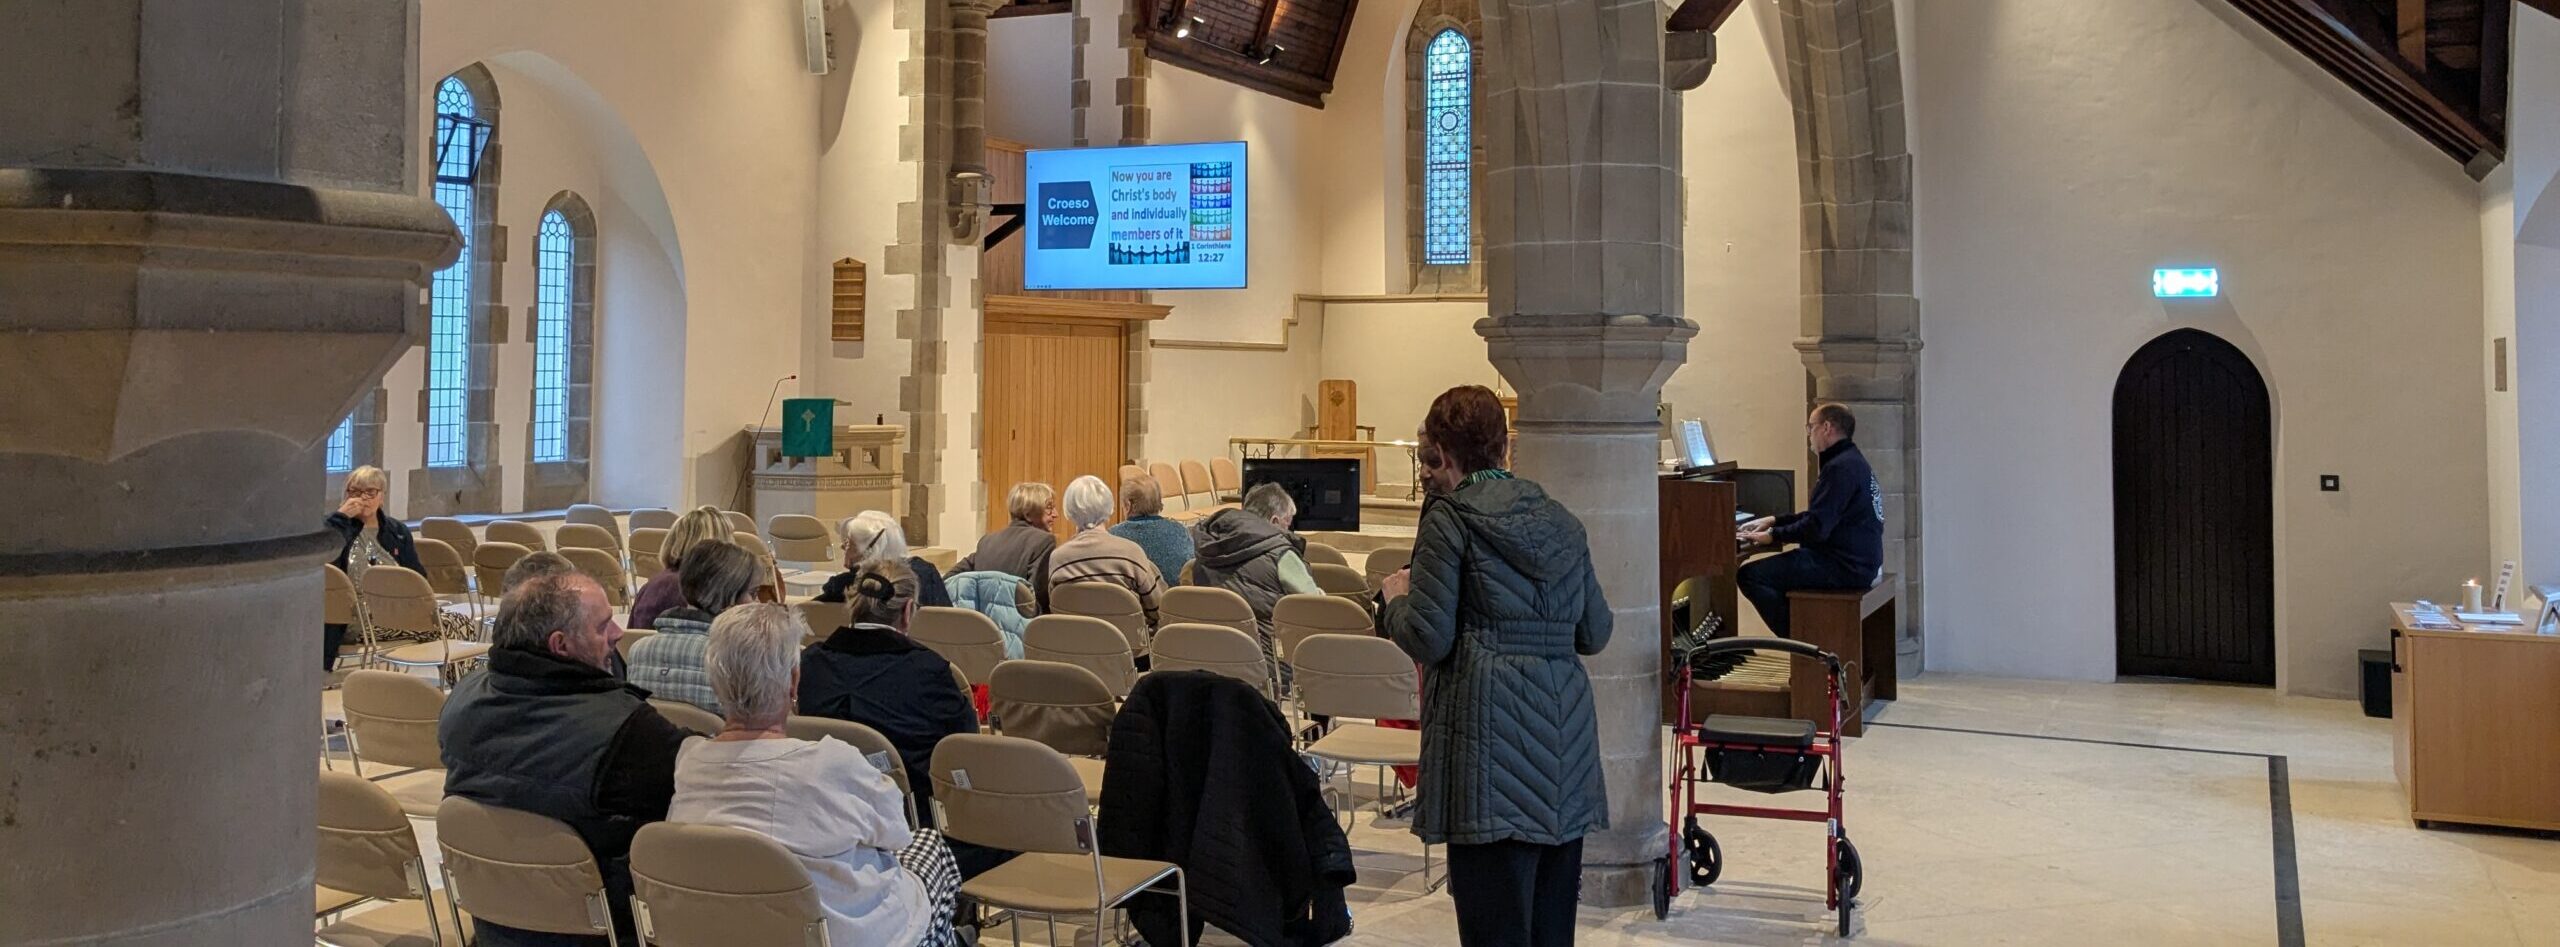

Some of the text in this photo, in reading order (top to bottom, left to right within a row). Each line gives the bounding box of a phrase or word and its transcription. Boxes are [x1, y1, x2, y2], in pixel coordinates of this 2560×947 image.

[1111, 170, 1172, 184] Now you are
[1111, 188, 1177, 203] Christ's body
[1047, 197, 1090, 210] Croeso
[1042, 213, 1095, 226] Welcome
[1111, 207, 1187, 221] and individually
[1111, 227, 1184, 241] members of it
[1198, 253, 1225, 263] 12:27
